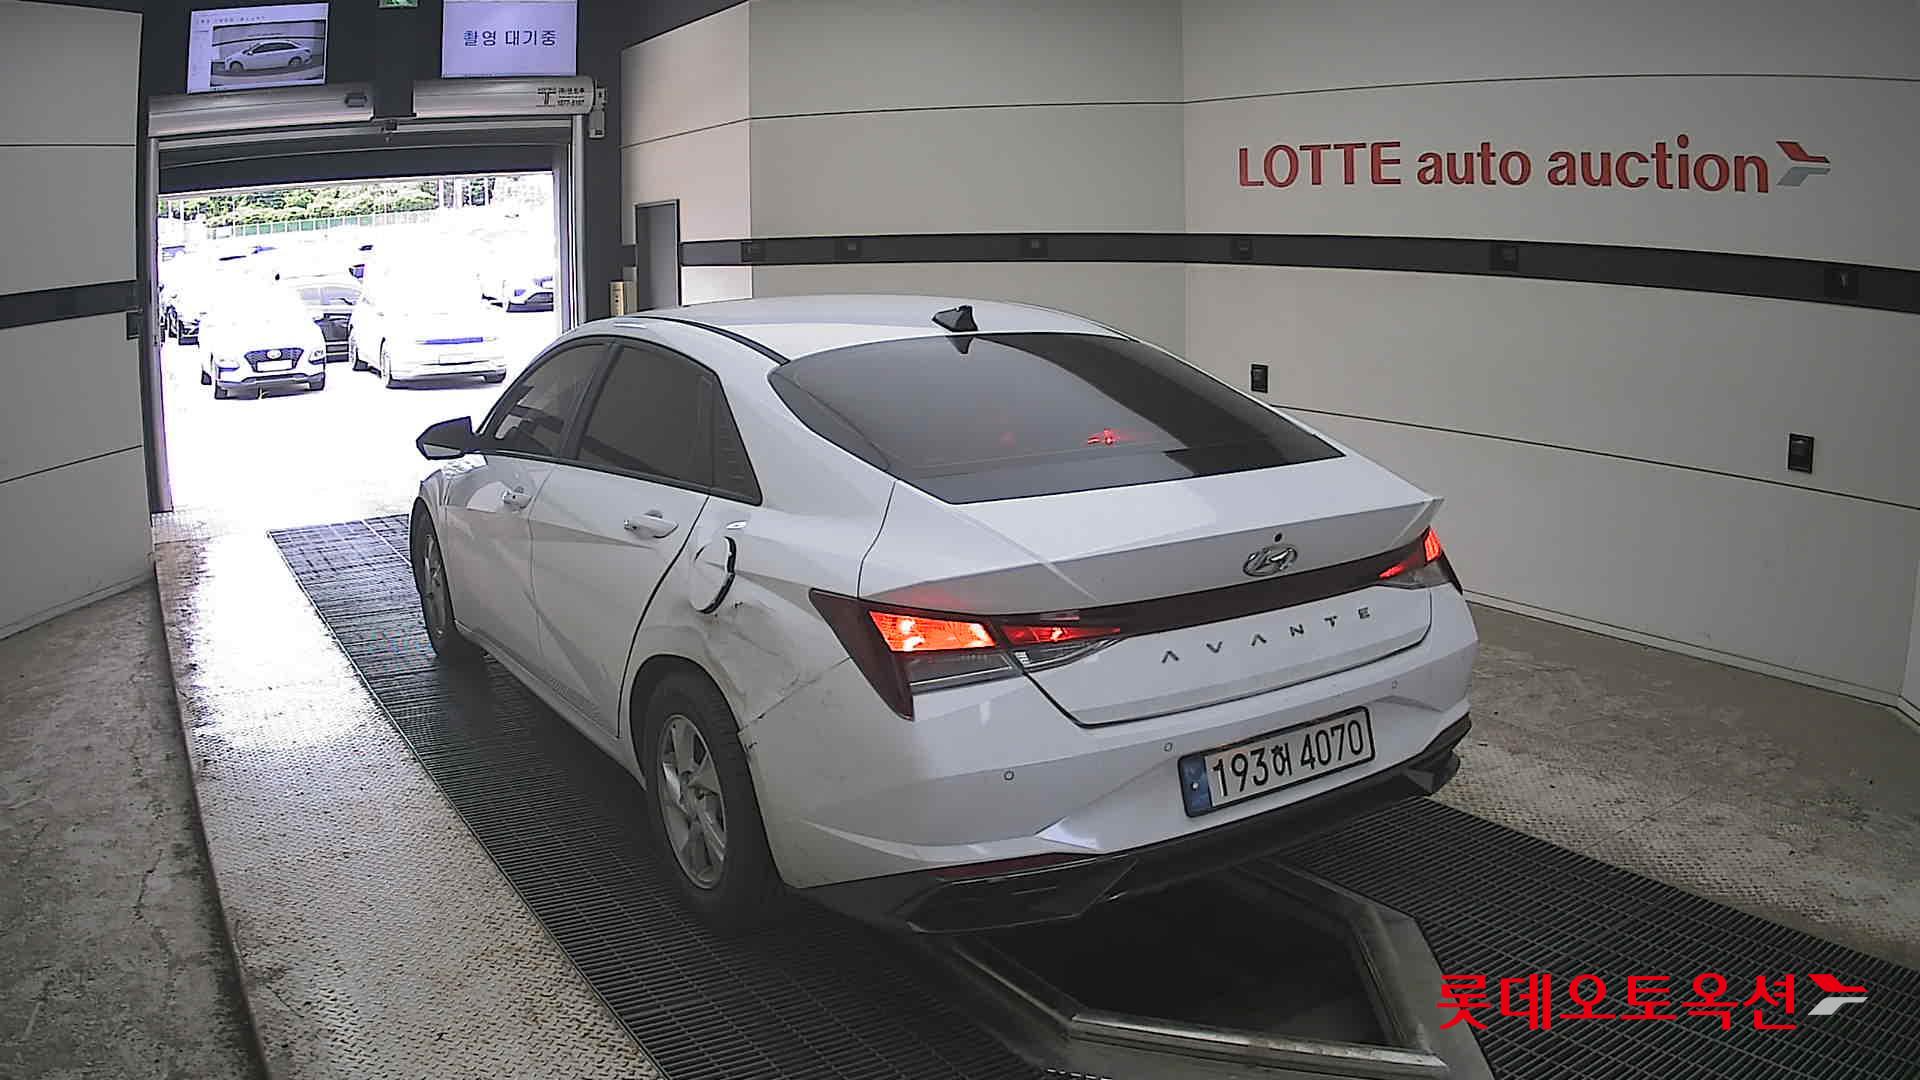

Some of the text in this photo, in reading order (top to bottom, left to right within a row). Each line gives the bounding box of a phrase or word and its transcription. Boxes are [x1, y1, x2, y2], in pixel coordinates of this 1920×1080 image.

[464, 30, 556, 46] 촬영 대기중
[1239, 134, 1769, 193] LOTTE auto auction
[1161, 606, 1371, 664] AVANTE
[1212, 719, 1364, 797] 193허 4070
